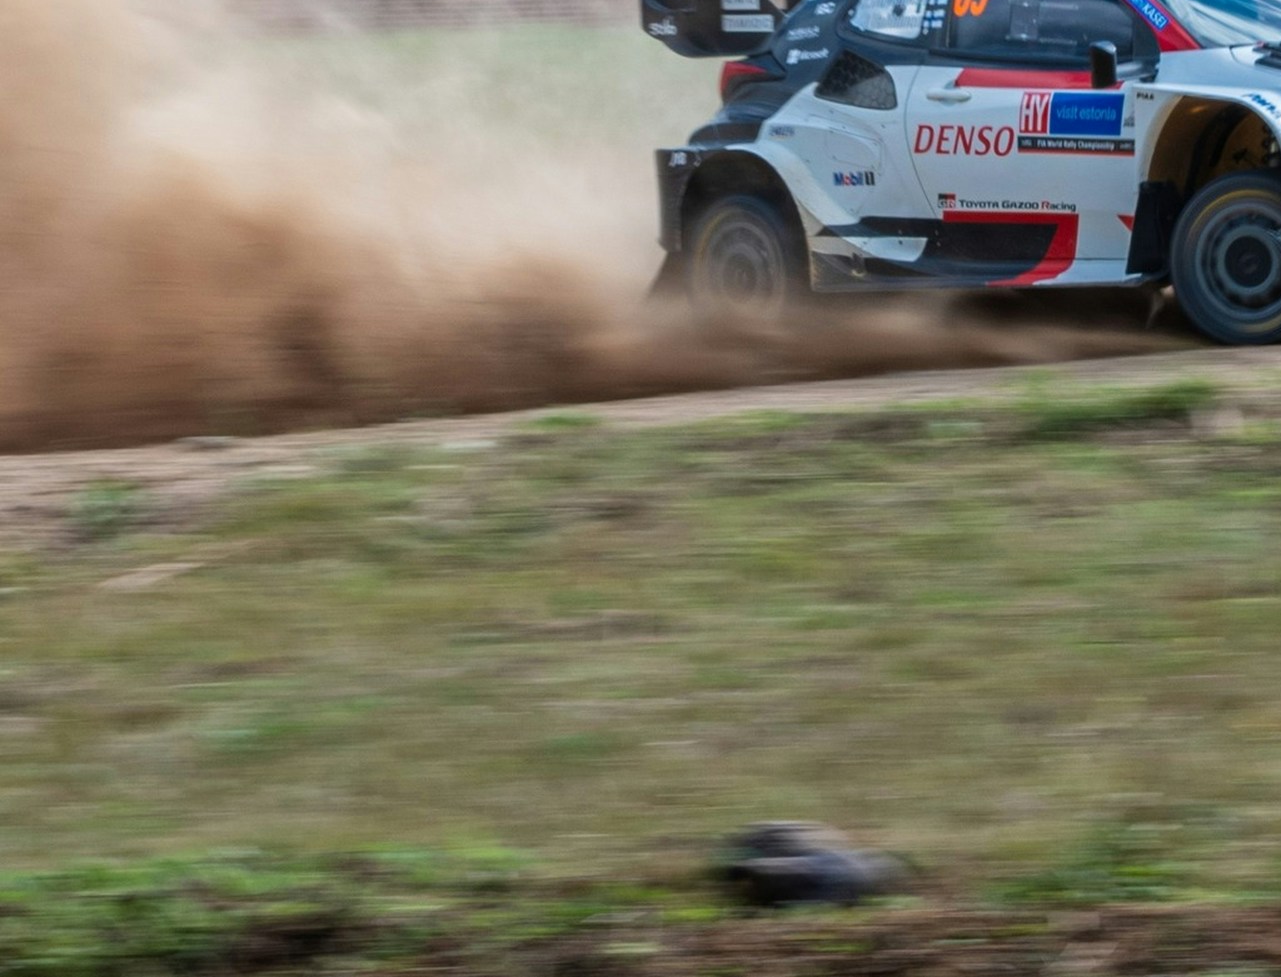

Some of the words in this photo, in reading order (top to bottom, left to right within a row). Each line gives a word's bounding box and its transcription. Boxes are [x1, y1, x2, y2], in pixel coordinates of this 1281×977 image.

[1021, 93, 1050, 132] HY
[1056, 106, 1078, 120] visit
[1080, 107, 1117, 121] estonia
[914, 124, 1015, 157] DENSO
[833, 172, 864, 186] Mobil
[959, 200, 999, 209] TOYOTA
[1002, 201, 1039, 209] GAZOO
[1042, 201, 1076, 212] Racing
